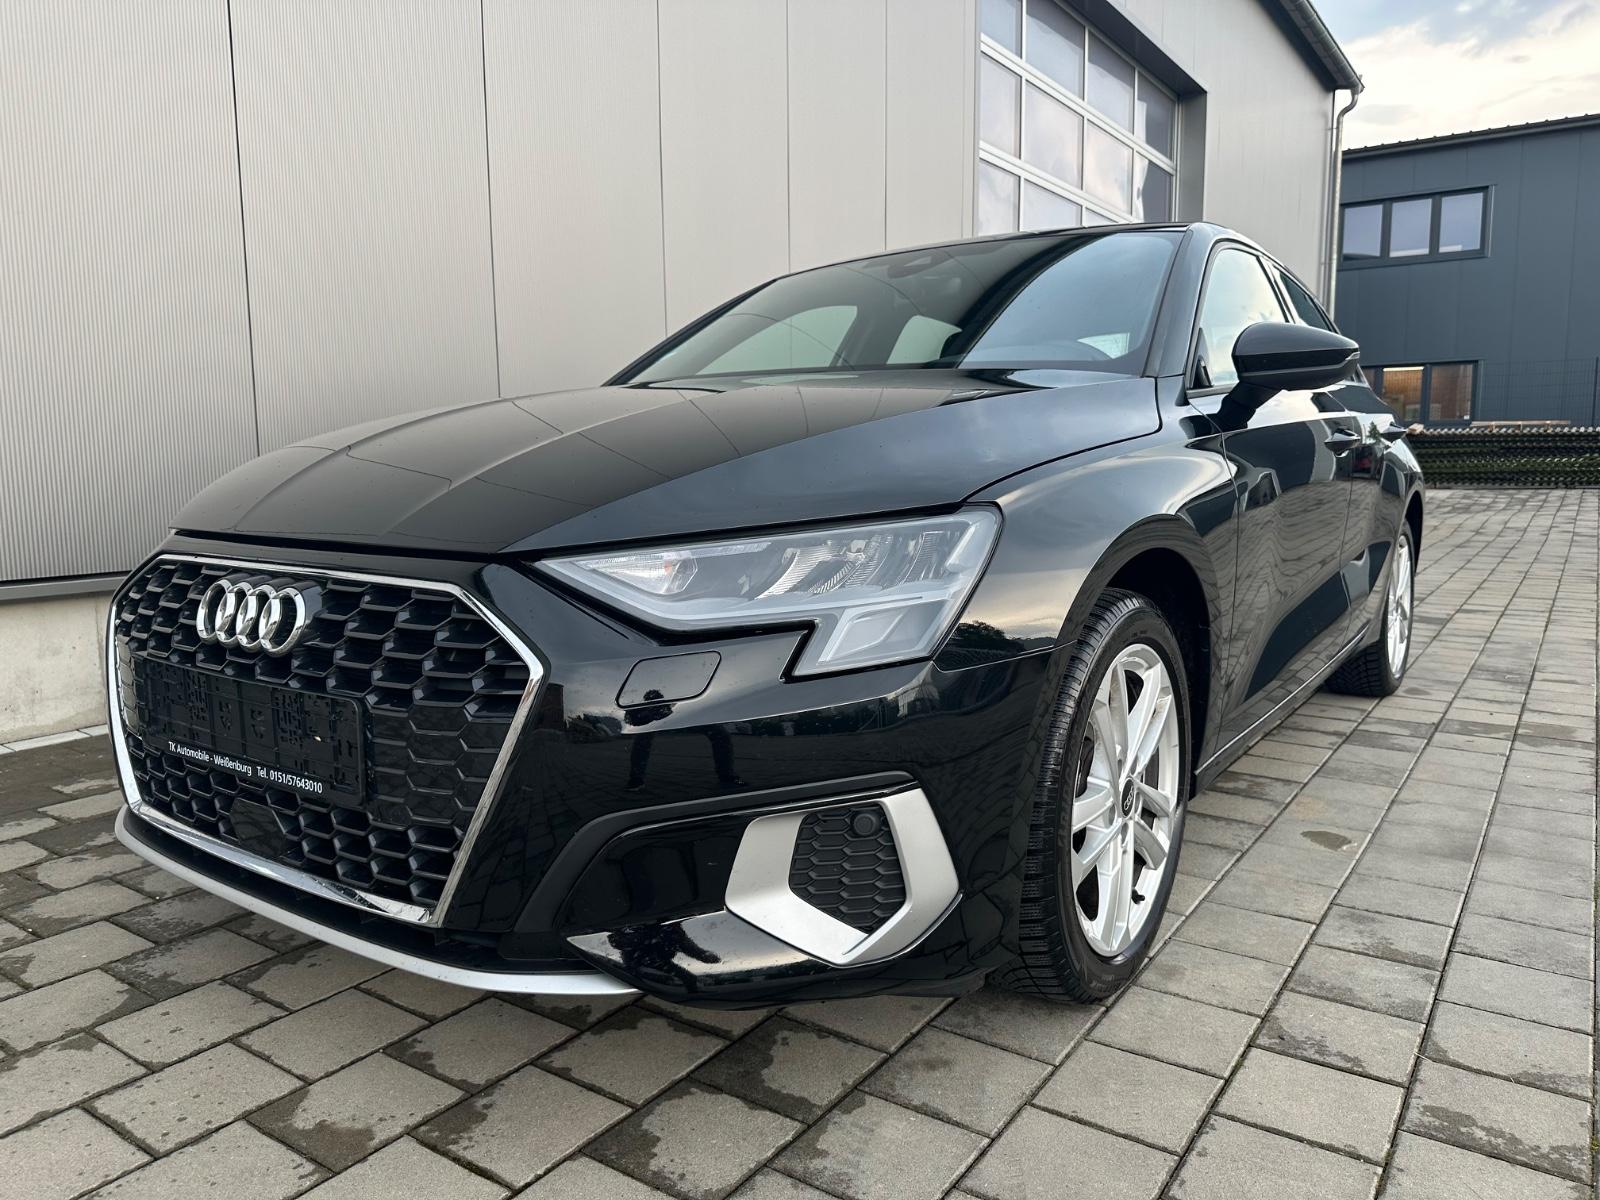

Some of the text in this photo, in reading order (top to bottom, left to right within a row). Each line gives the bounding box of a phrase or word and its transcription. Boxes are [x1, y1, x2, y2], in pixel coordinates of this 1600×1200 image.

[168, 741, 176, 753] TK
[177, 744, 210, 762] Automobile
[213, 754, 252, 777] Weißenburg
[257, 766, 269, 779] Tel.
[269, 769, 323, 794] 0151/57643010
